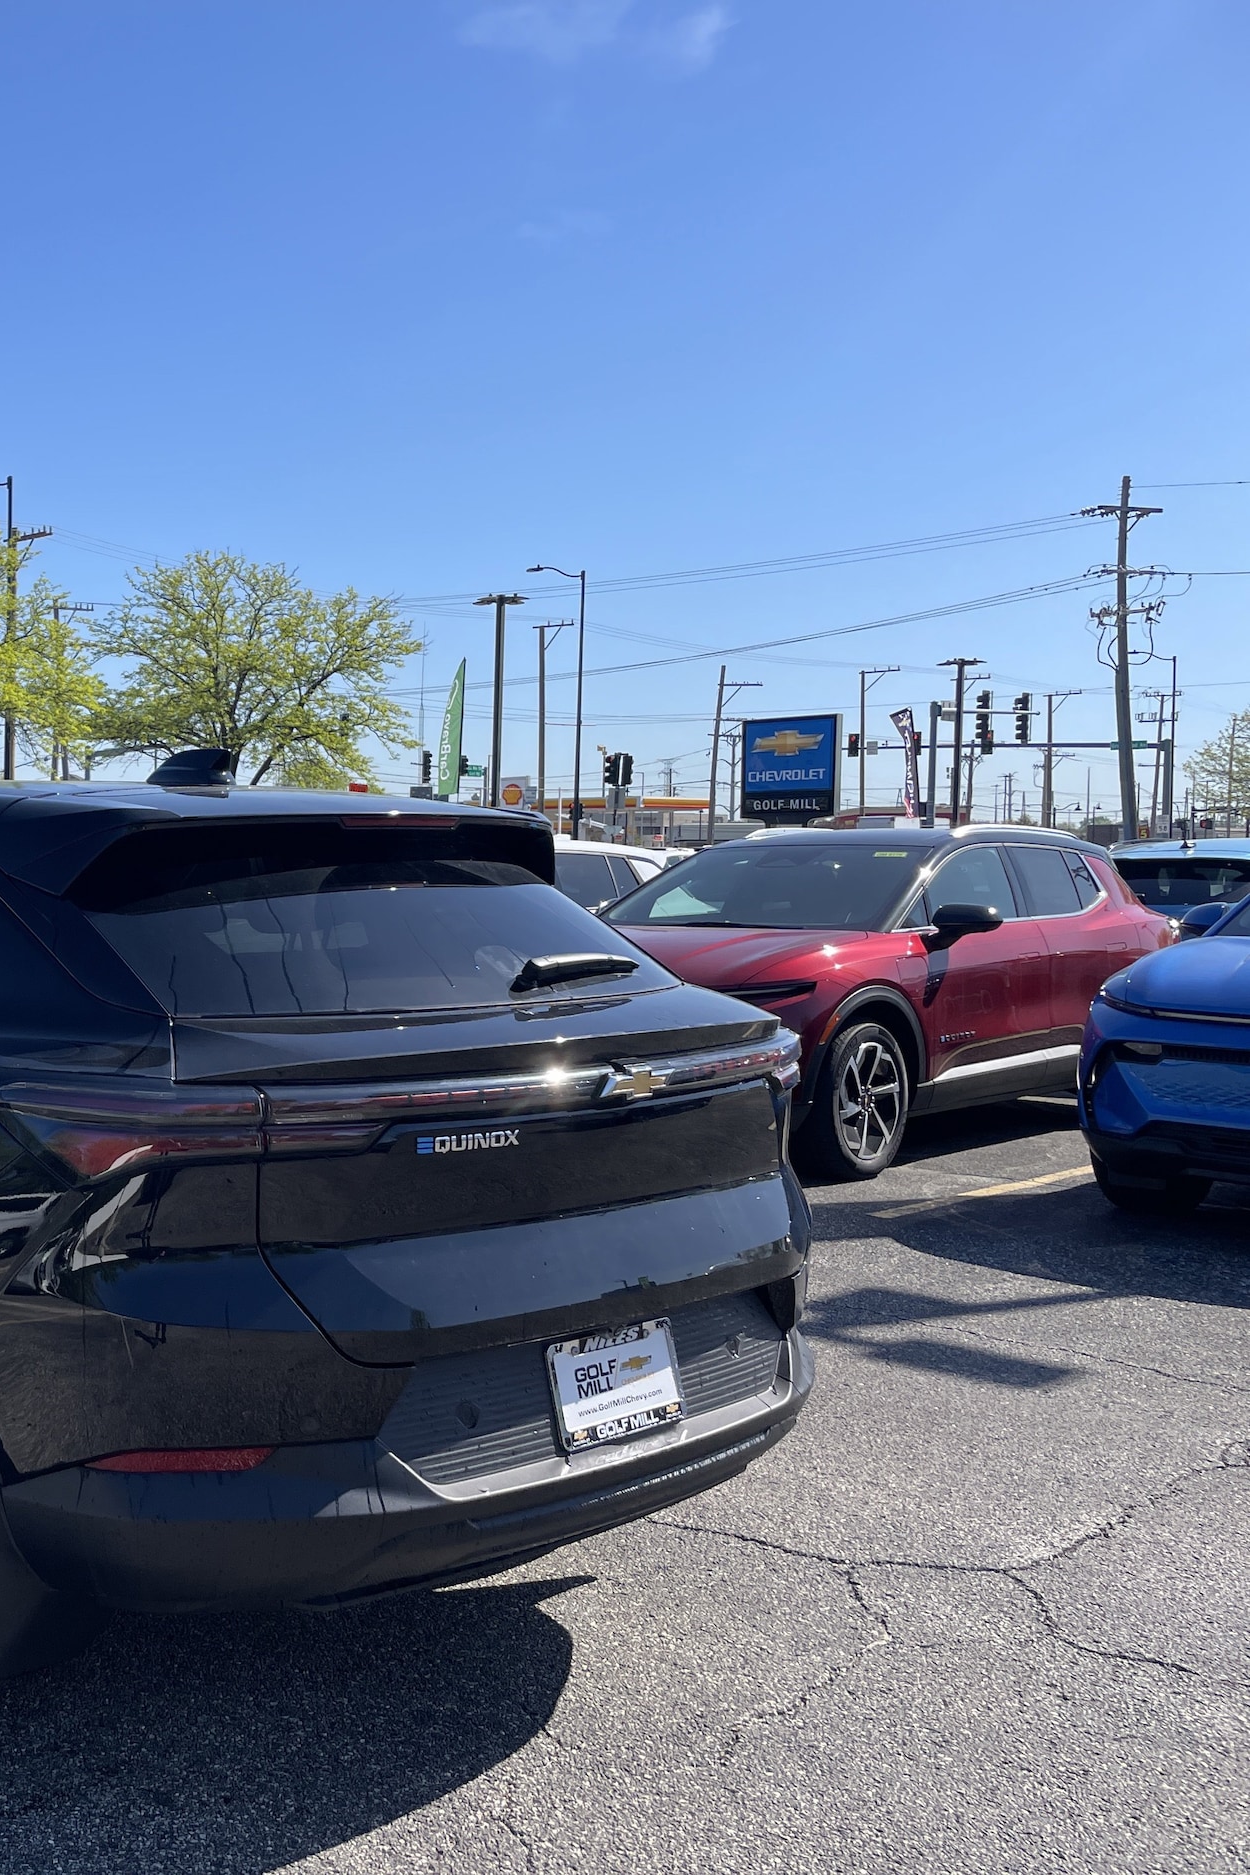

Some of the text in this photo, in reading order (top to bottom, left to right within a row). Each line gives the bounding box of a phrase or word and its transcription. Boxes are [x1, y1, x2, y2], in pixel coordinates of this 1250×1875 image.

[440, 714, 451, 780] CarBravo
[748, 768, 826, 783] CHEVROLET
[753, 798, 820, 811] GOLF MILL
[574, 1358, 617, 1383] GOLF
[577, 1376, 614, 1399] MILL
[577, 1387, 663, 1417] www.GolfMillChevy.com
